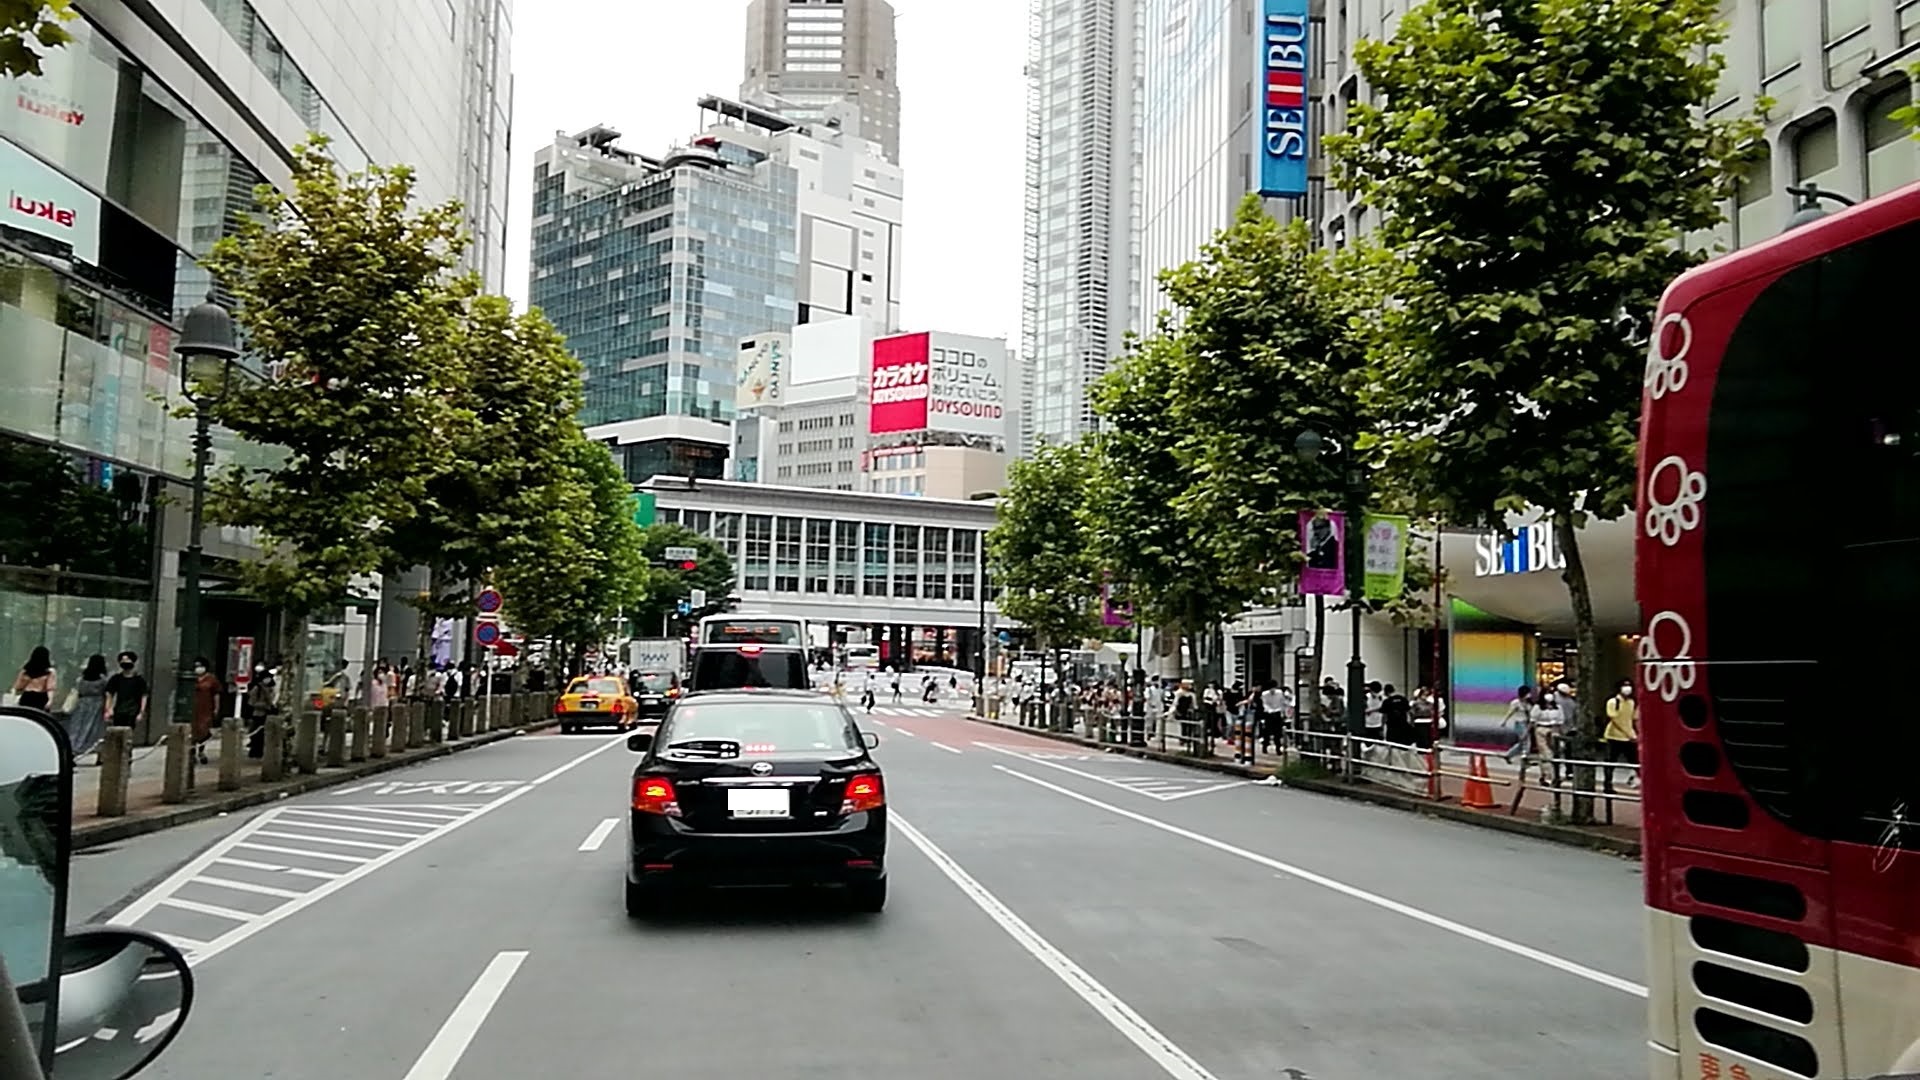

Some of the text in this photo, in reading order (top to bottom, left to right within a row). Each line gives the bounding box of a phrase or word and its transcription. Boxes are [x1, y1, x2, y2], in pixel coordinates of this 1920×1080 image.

[1267, 14, 1305, 157] SEIBU
[932, 347, 988, 369] ココロの
[872, 362, 928, 388] カラオケ
[929, 399, 1003, 419] JOYSOUND
